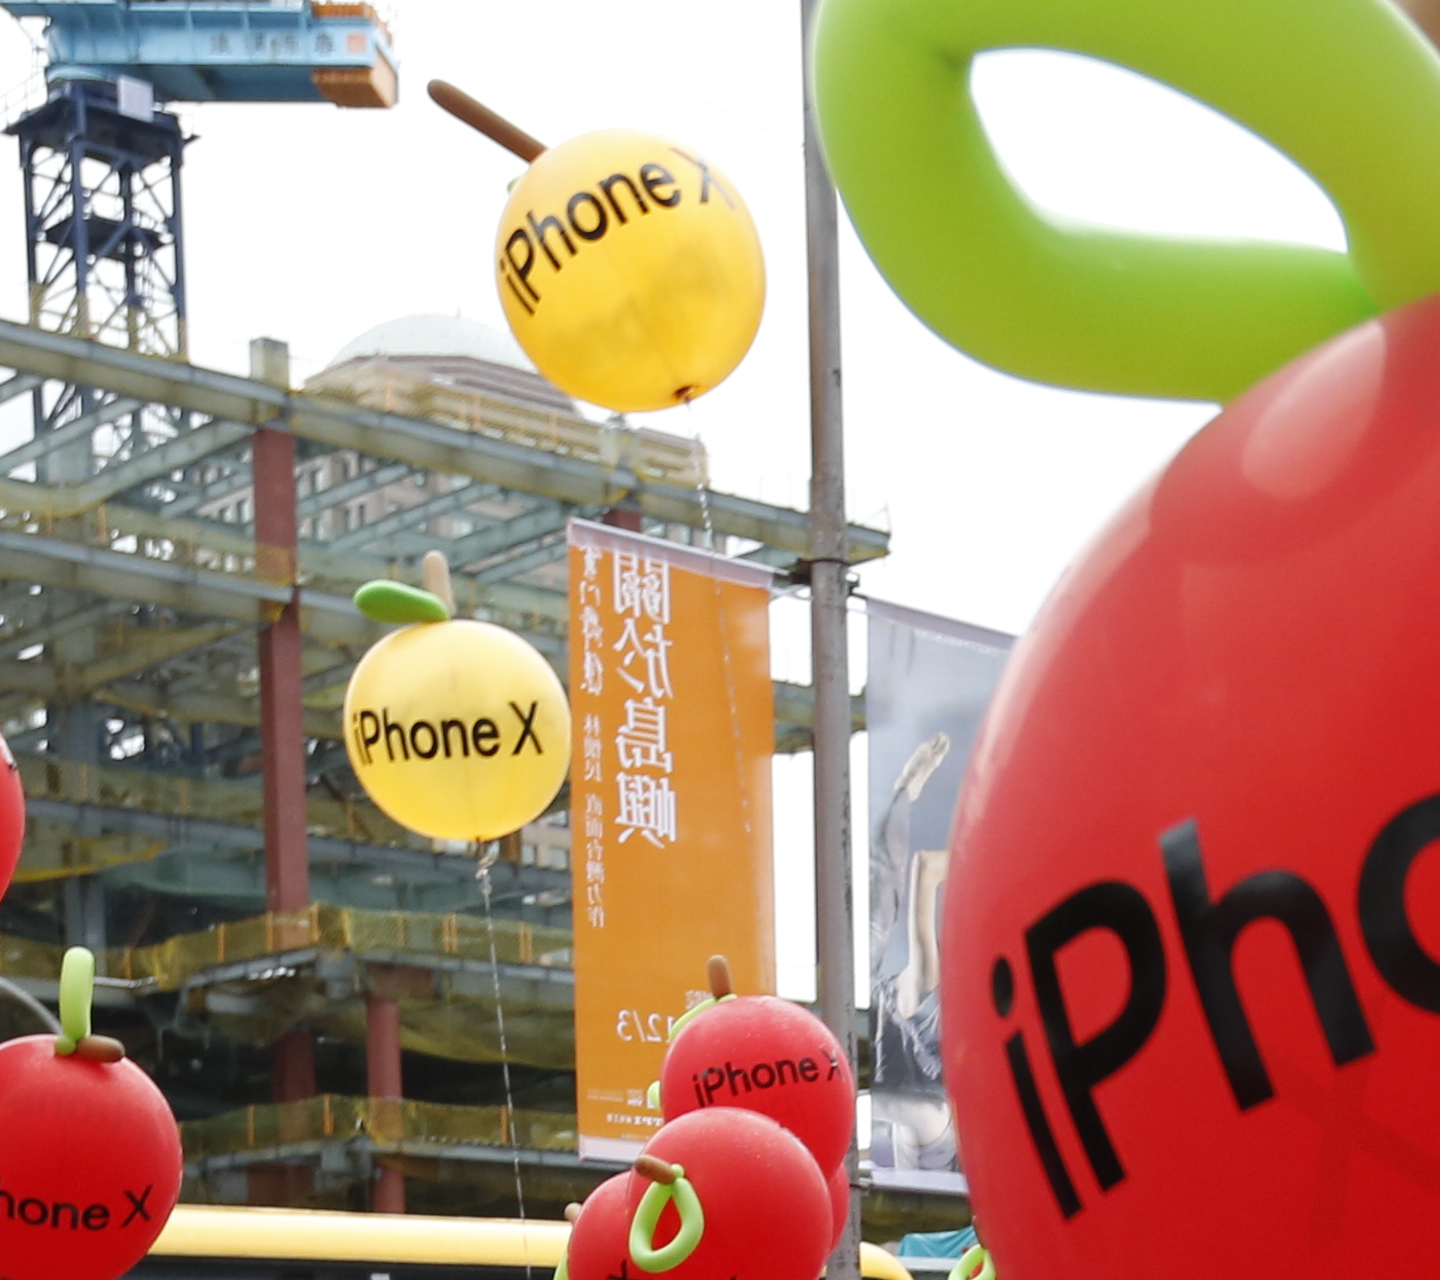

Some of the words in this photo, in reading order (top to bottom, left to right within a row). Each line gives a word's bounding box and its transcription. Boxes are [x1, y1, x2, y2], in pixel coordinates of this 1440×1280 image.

[499, 159, 682, 317] iPhone
[668, 144, 739, 212] X
[352, 709, 500, 766] iPhone
[509, 700, 545, 757] X
[692, 1053, 820, 1109] iPhone
[121, 1185, 155, 1228] X
